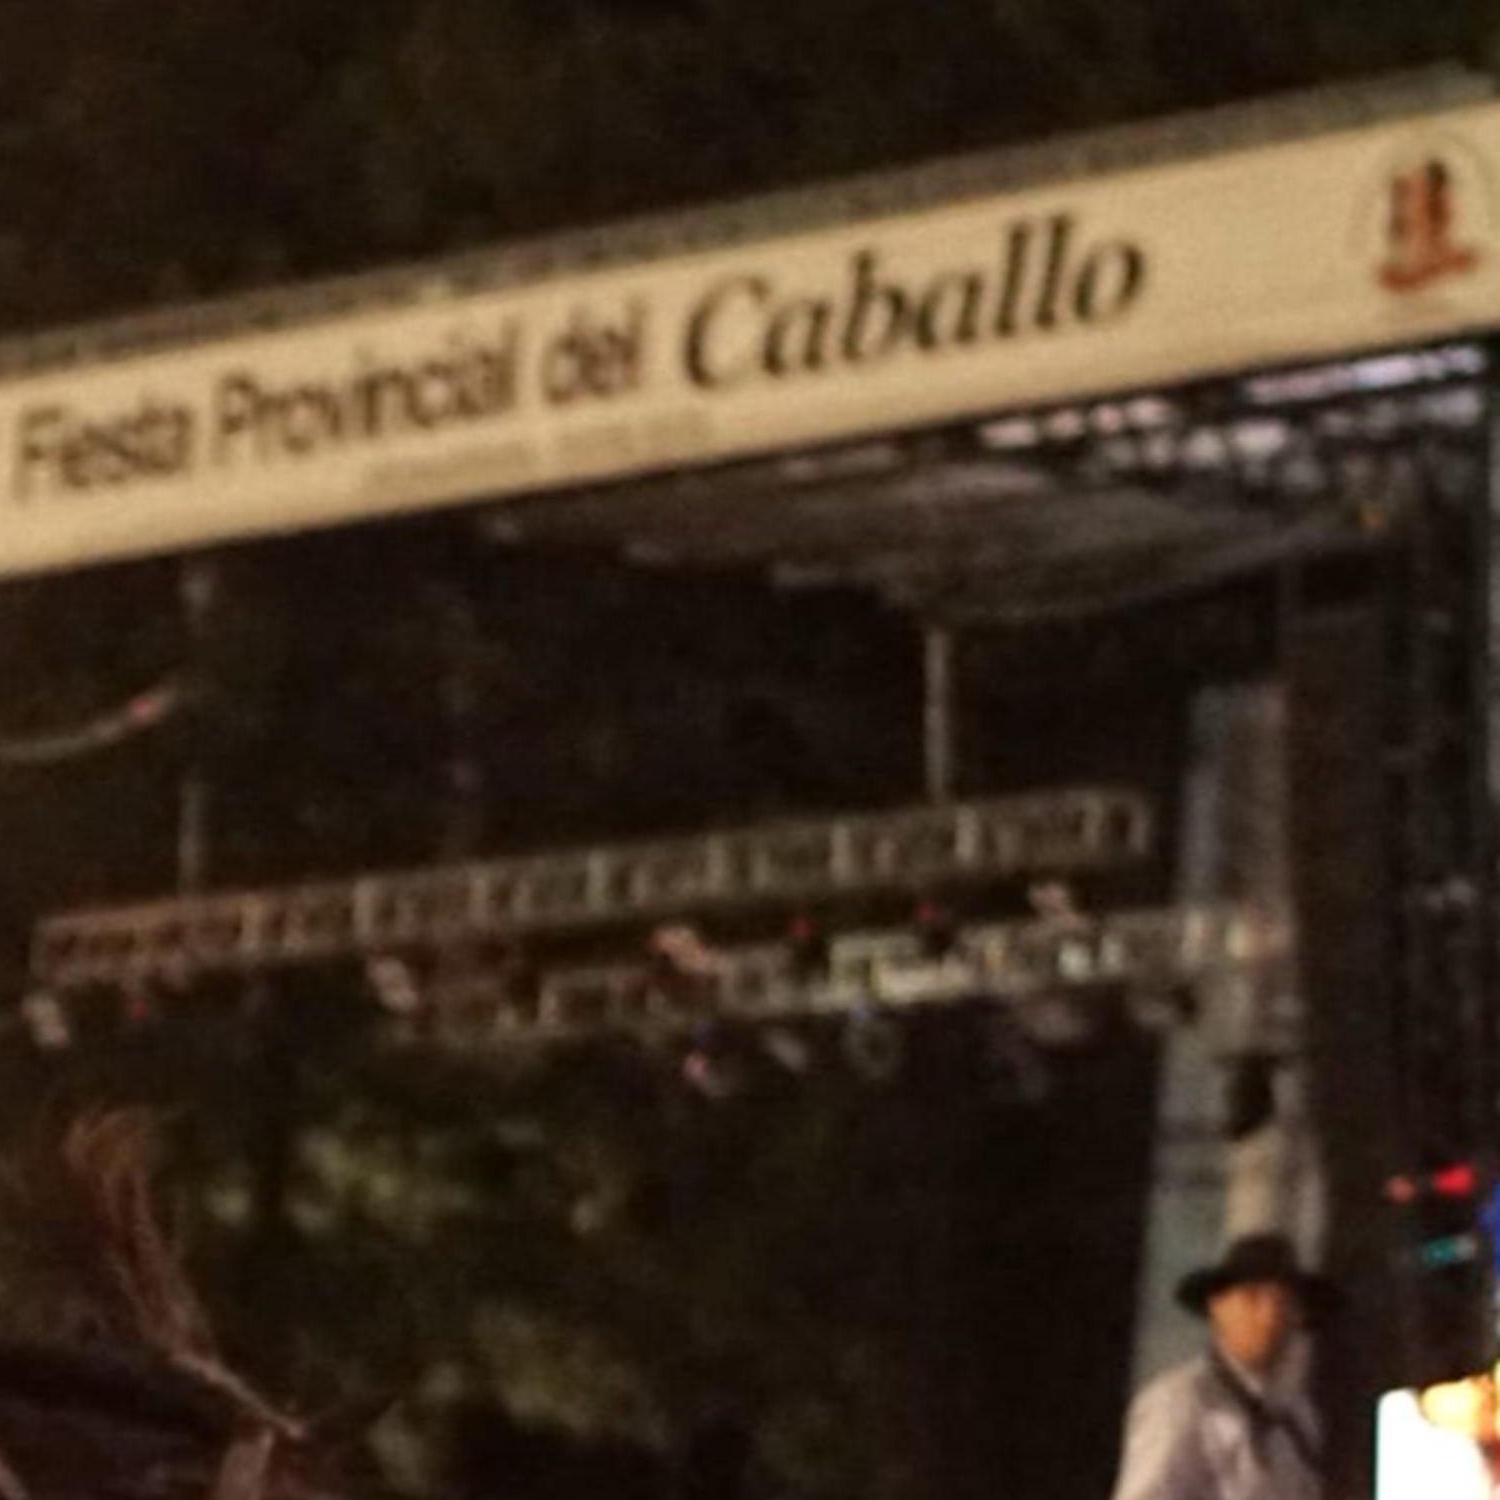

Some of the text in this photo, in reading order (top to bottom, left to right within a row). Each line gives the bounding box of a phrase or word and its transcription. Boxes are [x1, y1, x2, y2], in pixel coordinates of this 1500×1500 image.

[12, 403, 193, 500] Fiesta
[208, 316, 520, 464] Provincial
[543, 296, 652, 406] del
[682, 215, 1146, 388] Caballo
